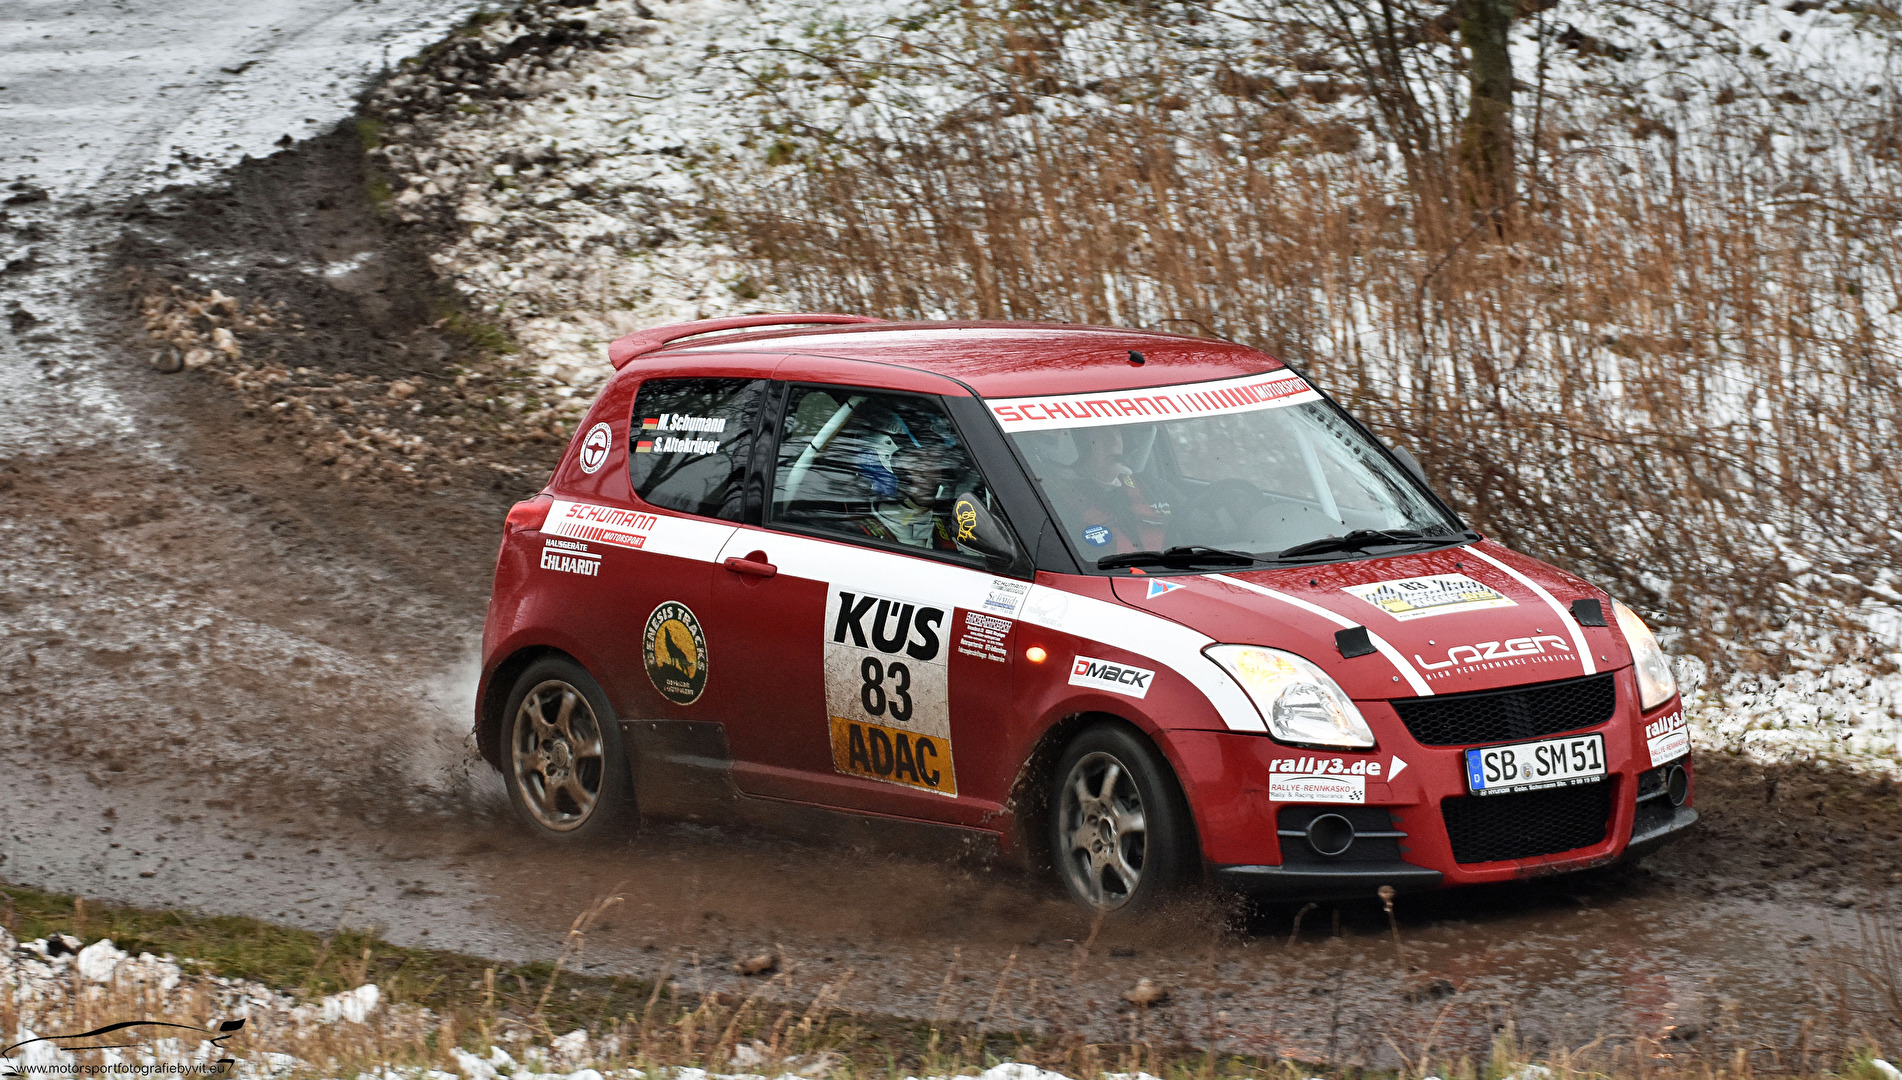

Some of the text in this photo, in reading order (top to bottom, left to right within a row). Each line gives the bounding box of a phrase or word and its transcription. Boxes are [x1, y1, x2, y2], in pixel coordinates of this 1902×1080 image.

[993, 378, 1307, 422] SCHUMANN MOTORSPORT
[657, 413, 726, 433] M. Schumann
[653, 436, 720, 455] S. Altekrüger
[566, 504, 657, 531] SCHUMANN
[545, 538, 588, 552] HAUSGERÄTE
[602, 530, 645, 546] MOTORSPORT
[540, 546, 602, 577] EHLHARDT
[646, 606, 706, 671] GENESIS TRACKS
[833, 591, 945, 661] KÜS
[1414, 634, 1570, 670] LAZER
[1425, 653, 1576, 681] HIGH PERFORMANCE LIGHTING
[861, 656, 913, 721] 83
[849, 723, 940, 787] ADAC
[1268, 757, 1381, 775] rally3.de
[1485, 750, 1518, 782] SB
[1271, 783, 1351, 793] RALLYE-RENNKASKO
[1474, 773, 1480, 783] D
